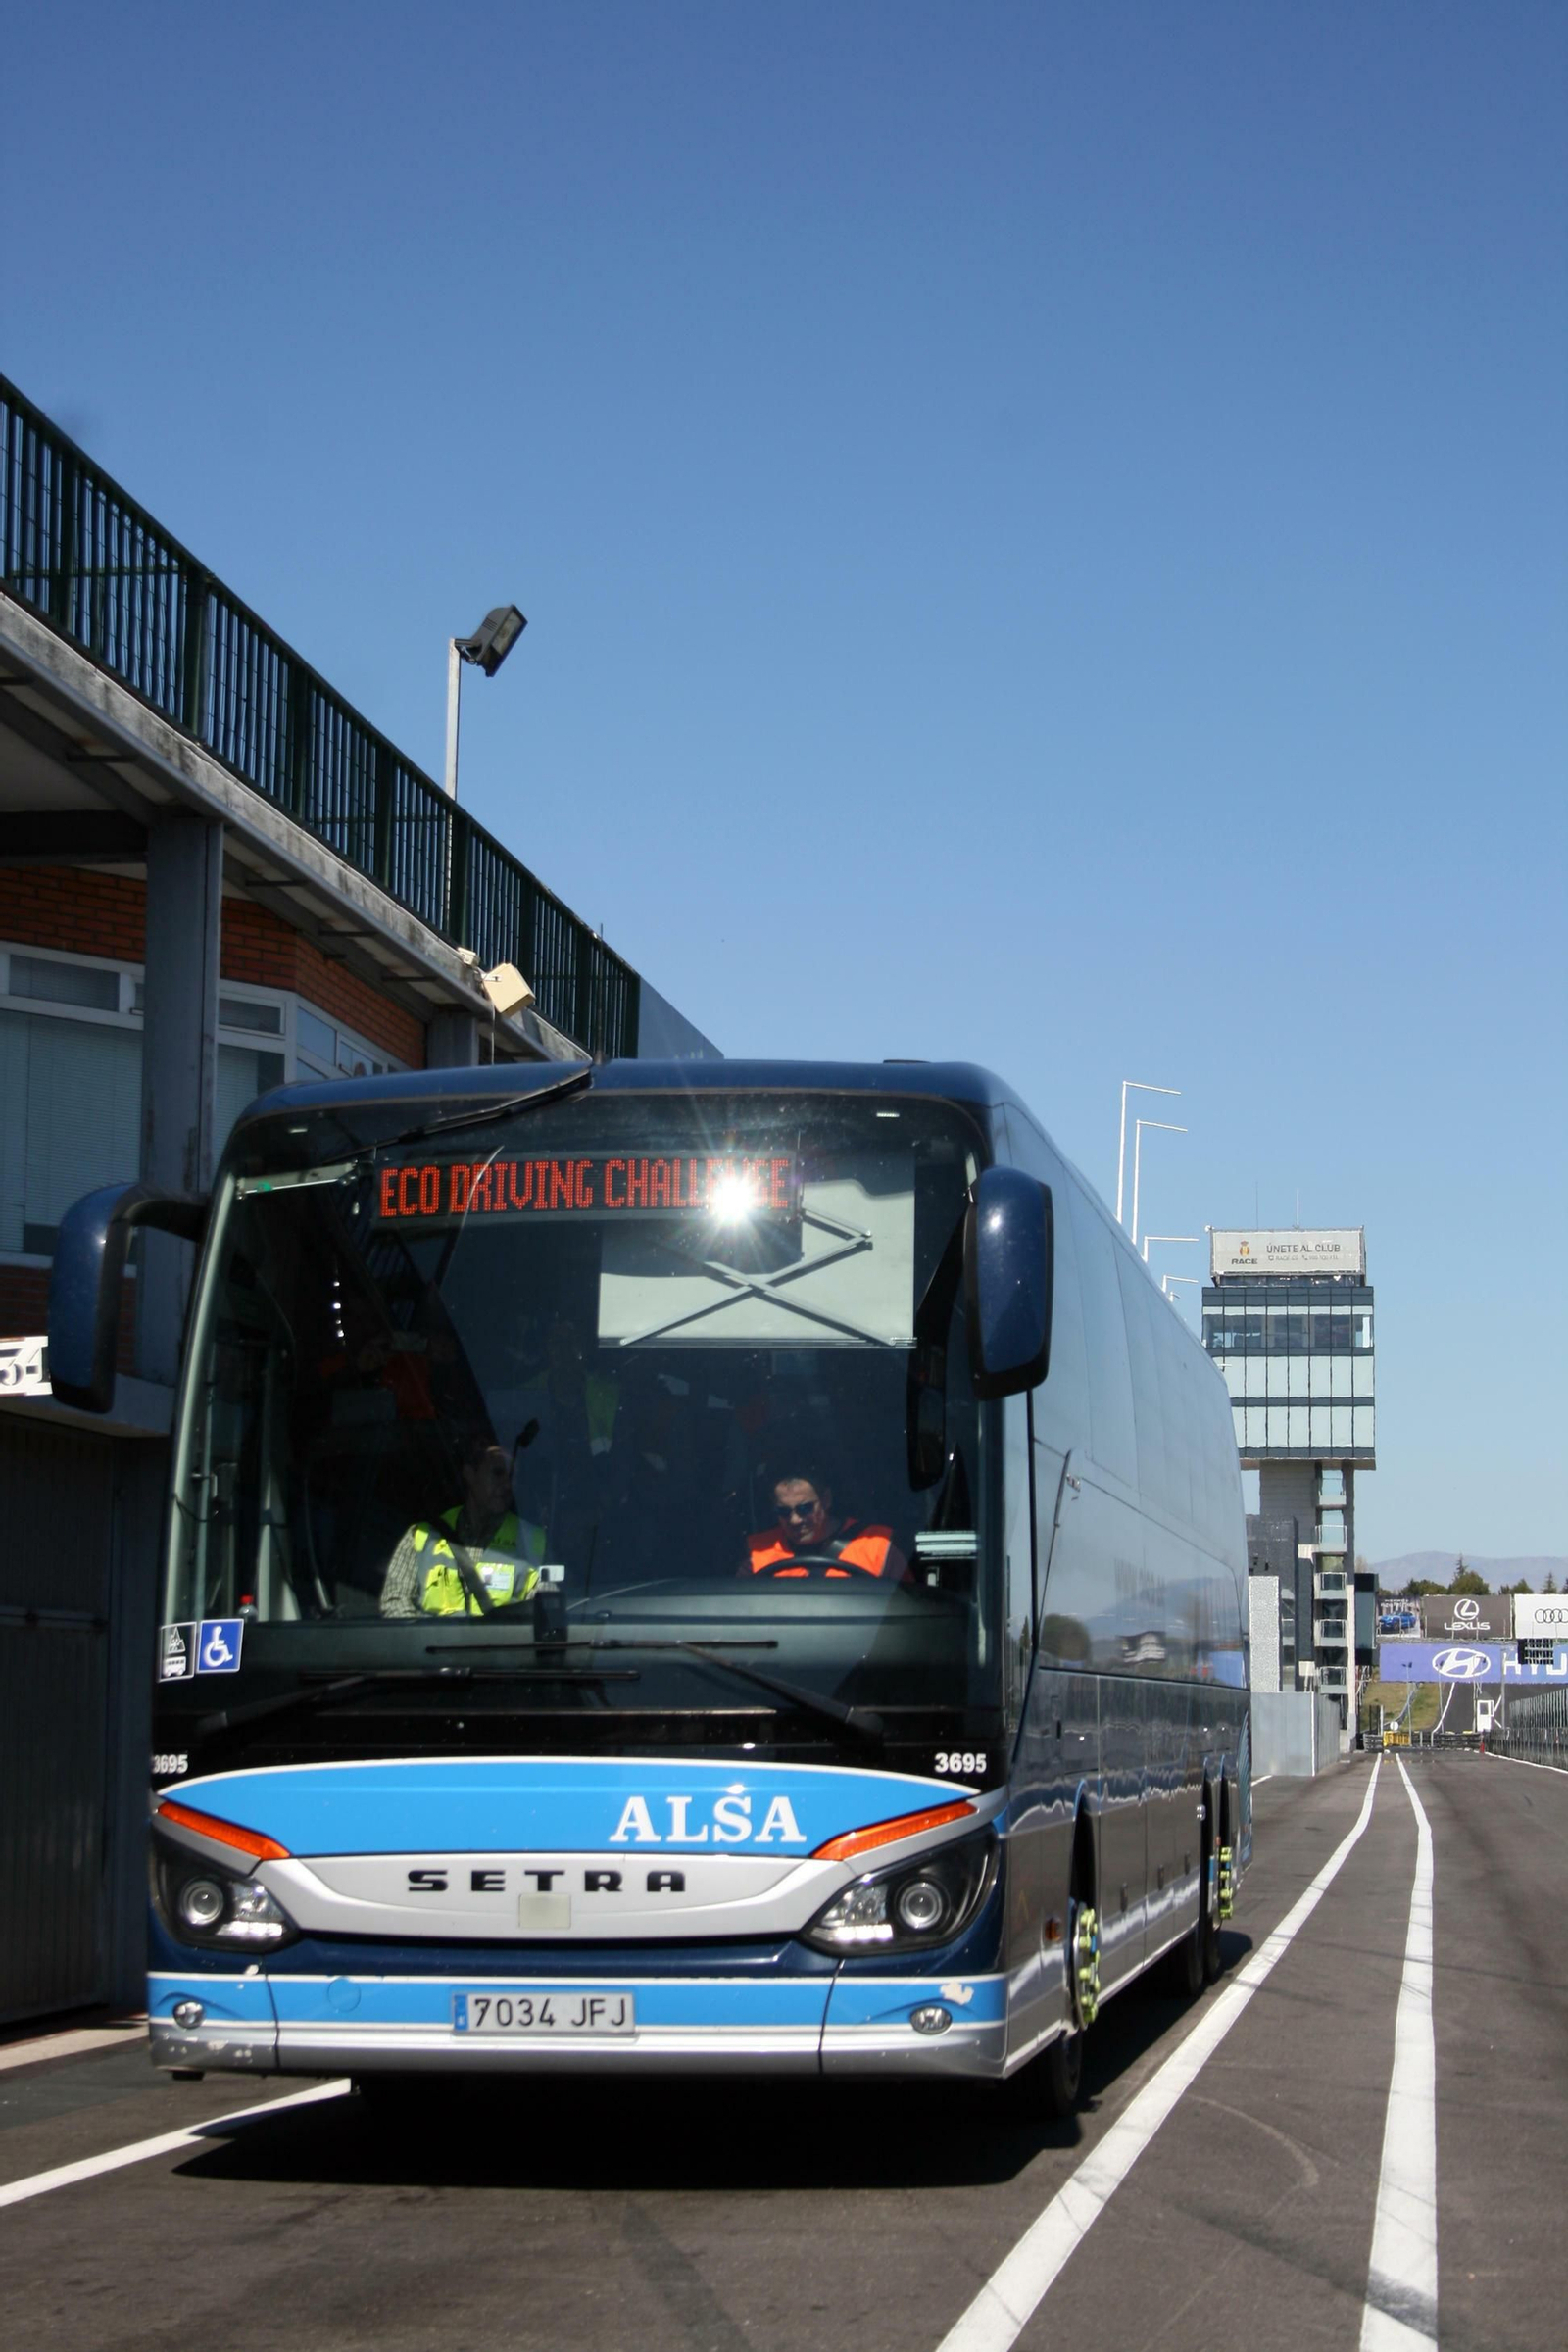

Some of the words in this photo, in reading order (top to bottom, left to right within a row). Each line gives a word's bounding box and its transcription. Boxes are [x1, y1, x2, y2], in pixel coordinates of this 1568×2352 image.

[380, 1166, 440, 1217] ECO
[450, 1159, 593, 1213] DRIVING
[1266, 1242, 1298, 1253] ÚNETE
[1300, 1245, 1312, 1253] AL
[1315, 1244, 1341, 1253] CLUB
[1444, 1621, 1491, 1631] LEXUS
[153, 1754, 189, 1775] 3695
[934, 1752, 987, 1773] 3695
[609, 1794, 808, 1843] ALSA
[408, 1869, 686, 1892] SETRA
[474, 1998, 556, 2028] 7034
[571, 1997, 626, 2028] JFJ
